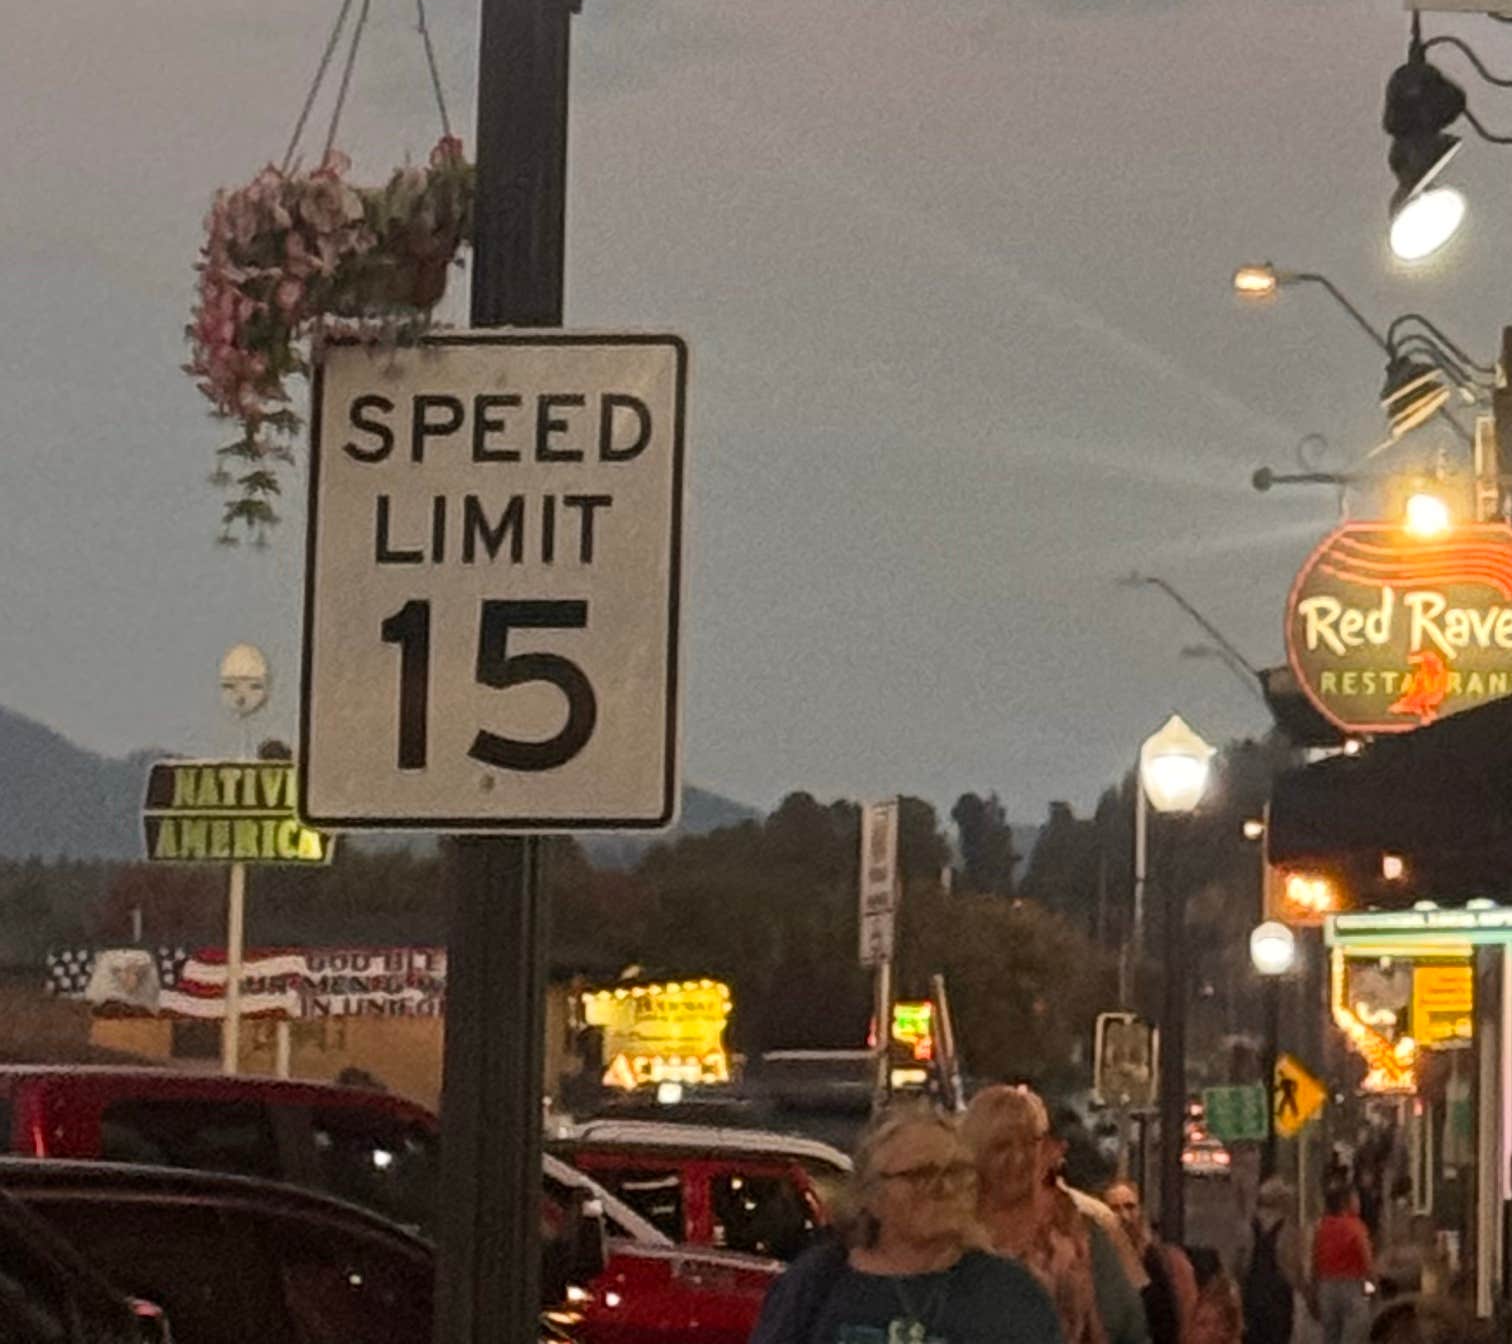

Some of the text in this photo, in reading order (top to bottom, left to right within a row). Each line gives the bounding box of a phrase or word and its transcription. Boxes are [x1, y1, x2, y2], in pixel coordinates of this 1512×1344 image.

[342, 393, 652, 463] SPEED
[374, 494, 614, 565] LIMIT
[1299, 586, 1394, 655] Red
[380, 598, 598, 772] 15
